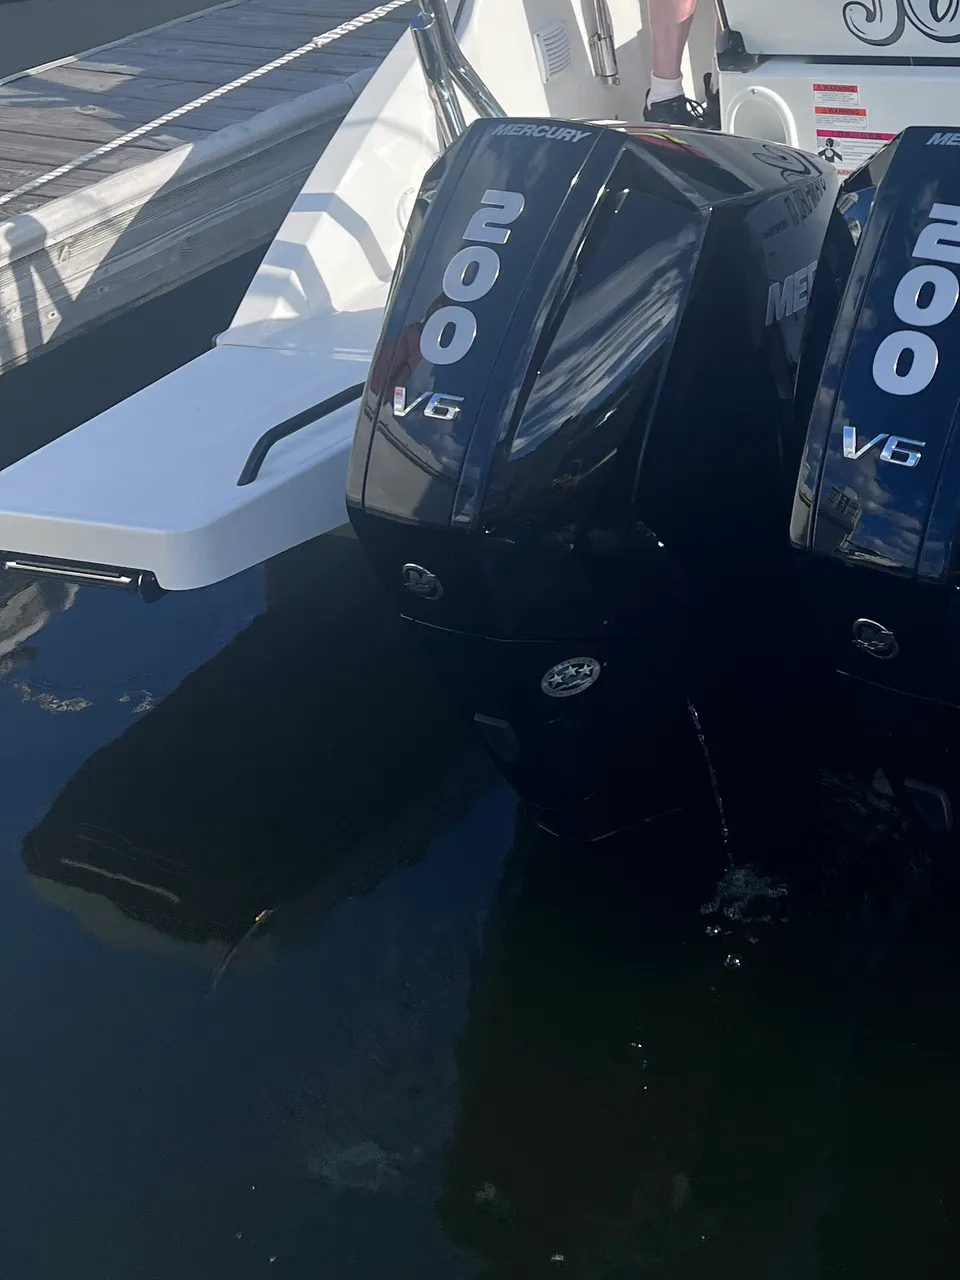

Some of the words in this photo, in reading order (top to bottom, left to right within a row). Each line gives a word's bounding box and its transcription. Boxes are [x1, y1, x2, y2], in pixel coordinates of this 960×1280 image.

[492, 123, 592, 143] MERCURY
[419, 189, 526, 366] 200
[393, 386, 465, 421] V6
[843, 425, 926, 468] V6
